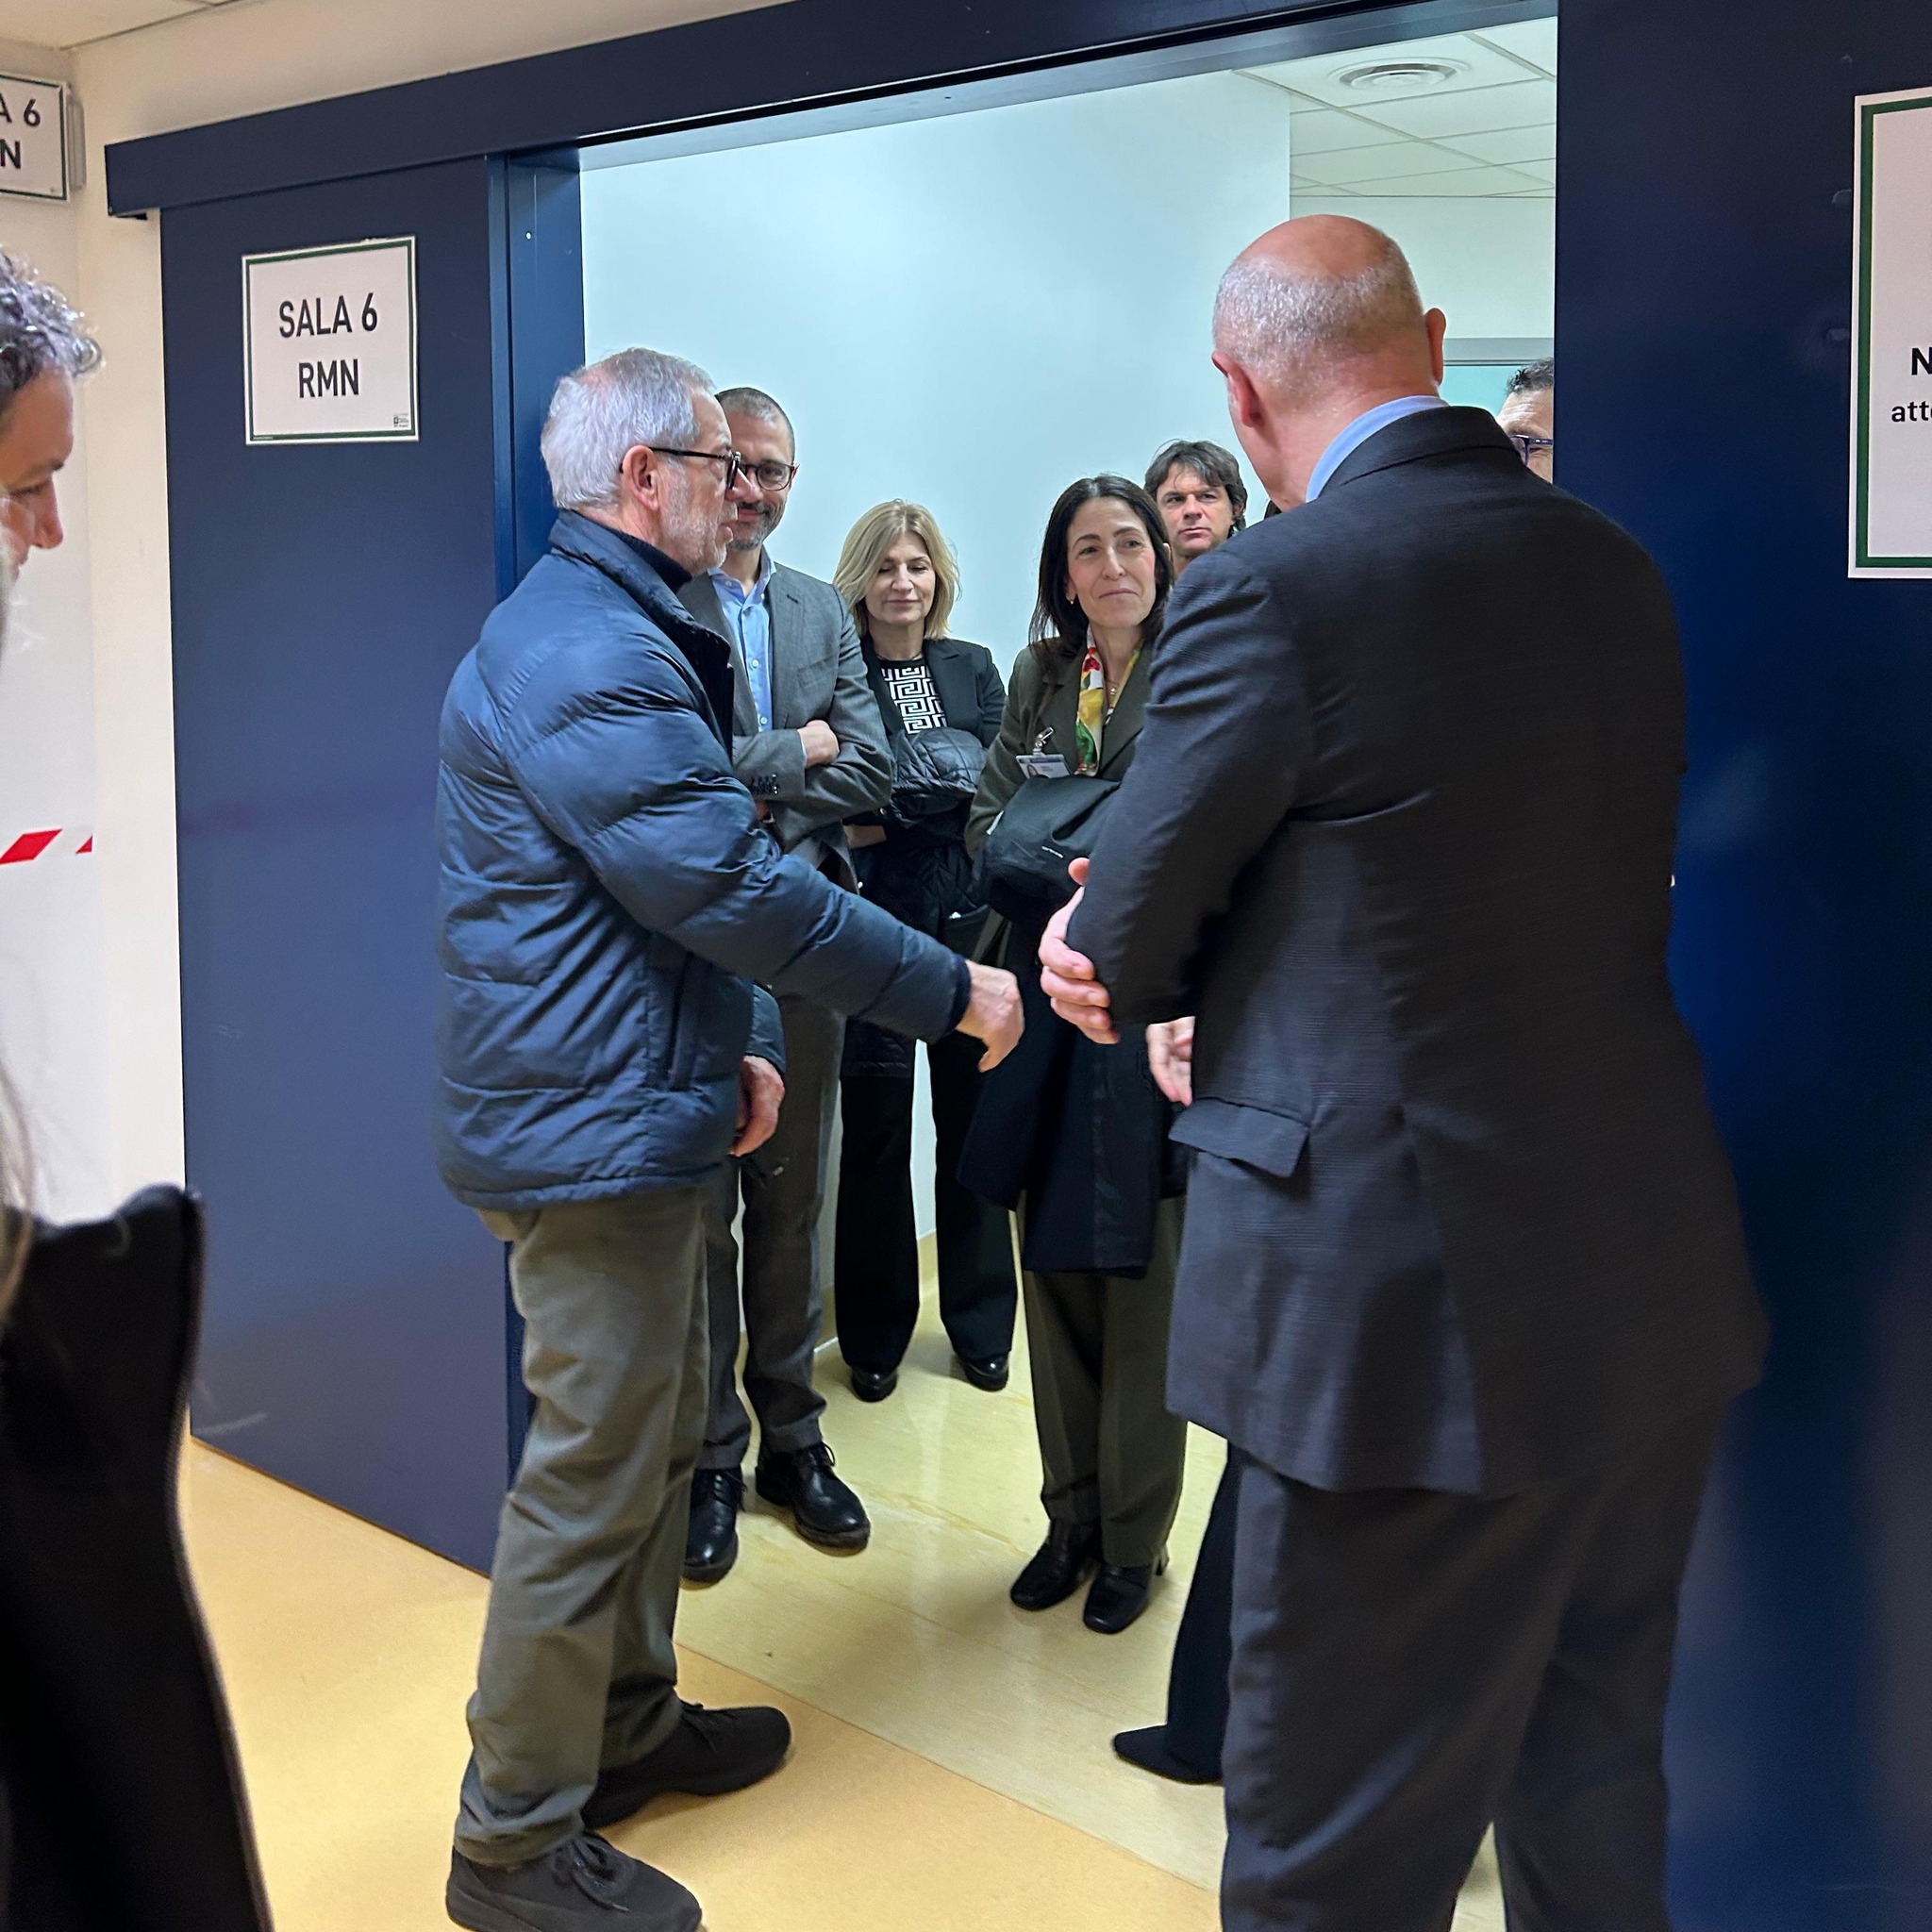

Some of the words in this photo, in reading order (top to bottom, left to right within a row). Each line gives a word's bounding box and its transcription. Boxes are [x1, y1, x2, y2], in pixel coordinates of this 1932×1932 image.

[24, 98, 41, 126] 6
[279, 294, 353, 339] SALA
[361, 292, 378, 332] 6
[298, 358, 359, 398] RMN
[1891, 401, 1932, 423] att
